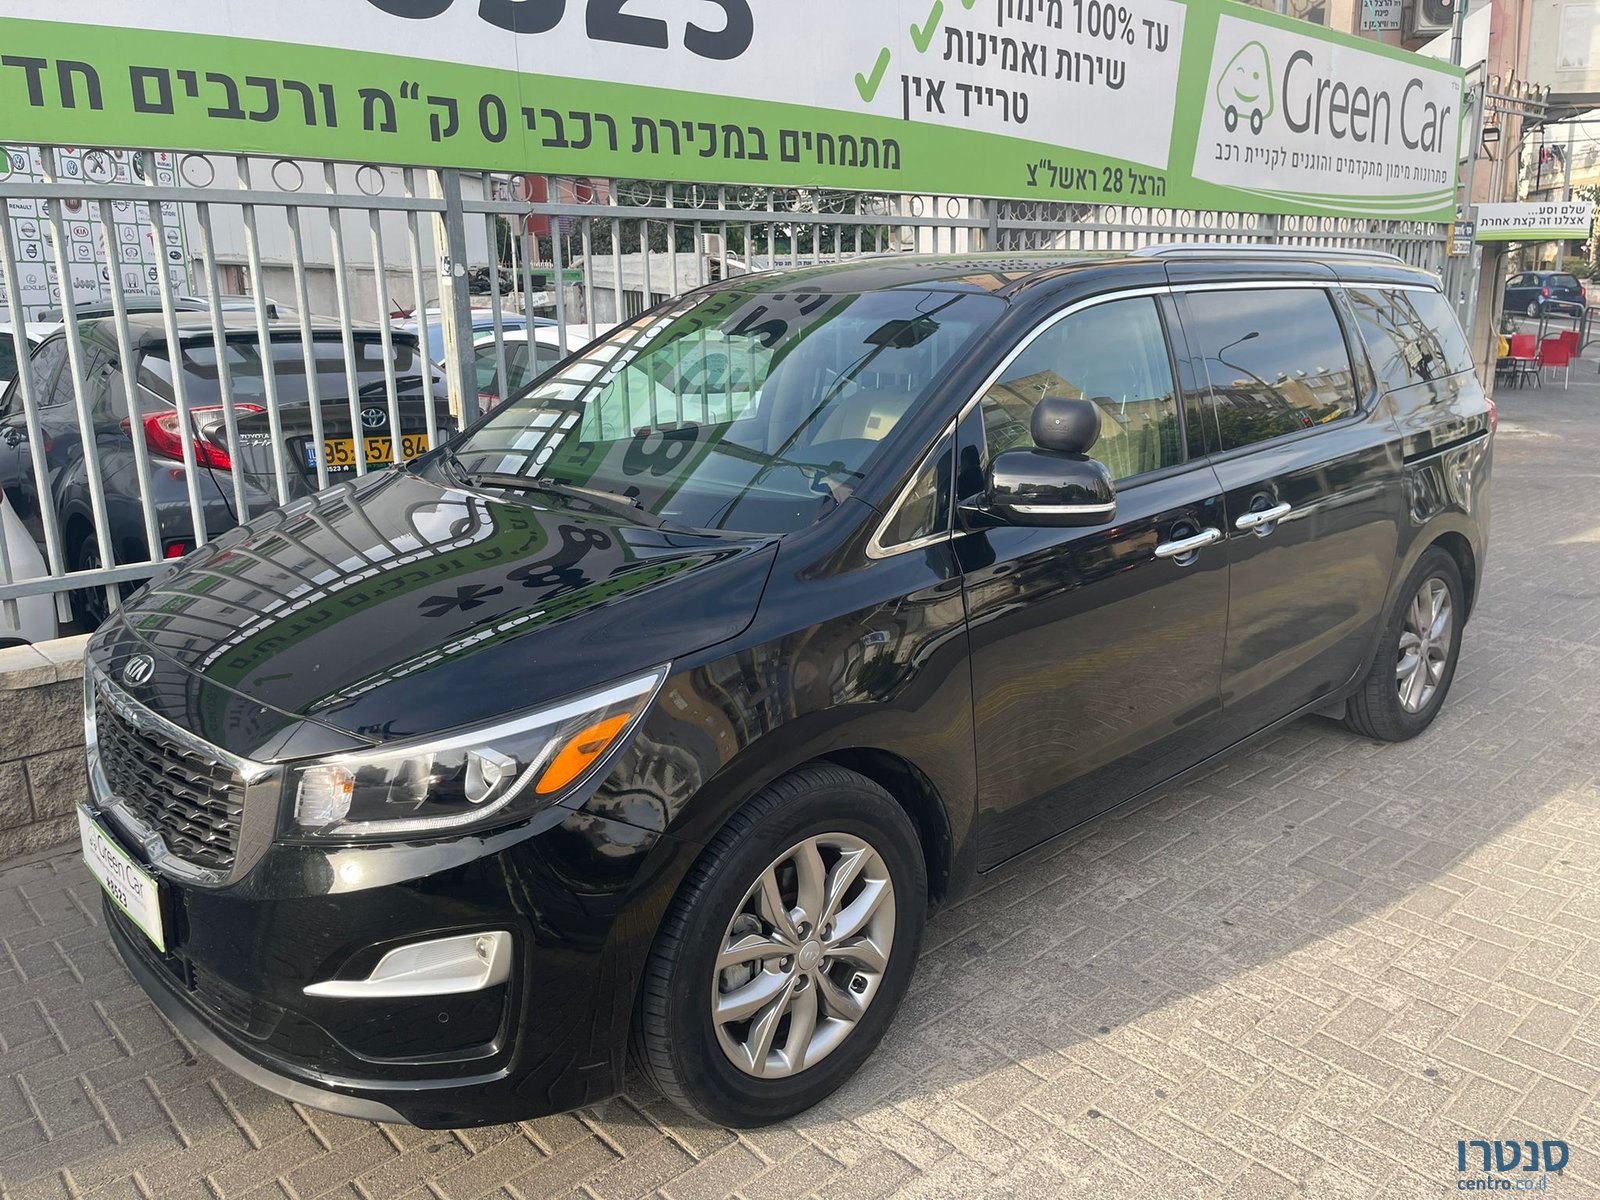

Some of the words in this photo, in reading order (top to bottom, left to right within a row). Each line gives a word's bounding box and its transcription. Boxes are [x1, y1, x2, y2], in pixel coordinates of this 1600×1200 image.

[997, 0, 1063, 29] מימון
[1073, 0, 1135, 46] 100%
[1142, 19, 1169, 52] עד
[943, 26, 1047, 77] ואמינות
[1055, 49, 1126, 90] שירות
[129, 65, 339, 128] ורכבים
[901, 75, 946, 121] אין
[956, 82, 1029, 124] טרייד
[1282, 49, 1391, 145] Green
[1400, 78, 1451, 154] Car
[479, 94, 508, 143] 0
[522, 107, 618, 151] רכבי
[632, 116, 769, 161] במכירת
[780, 129, 901, 170] מתמחים
[1214, 142, 1240, 162] רכב
[1244, 146, 1287, 171] לקניית
[1291, 152, 1332, 171] והוגנים
[1336, 157, 1383, 180] מתקדמים
[1386, 163, 1410, 182] מימון
[1026, 158, 1098, 191] ראשל"צ
[1102, 166, 1124, 194] 28
[1129, 168, 1167, 197] הרצל
[1413, 167, 1448, 184] פתרונות
[9, 203, 32, 211] RENAULT
[1539, 217, 1551, 225] זה
[1554, 216, 1584, 225] אצלנו
[1561, 205, 1586, 215] שלם
[1481, 217, 1510, 227] אחרת
[1513, 217, 1536, 227] קצת
[73, 278, 96, 290] Jeep
[98, 835, 126, 880] Green
[126, 865, 143, 898] Car
